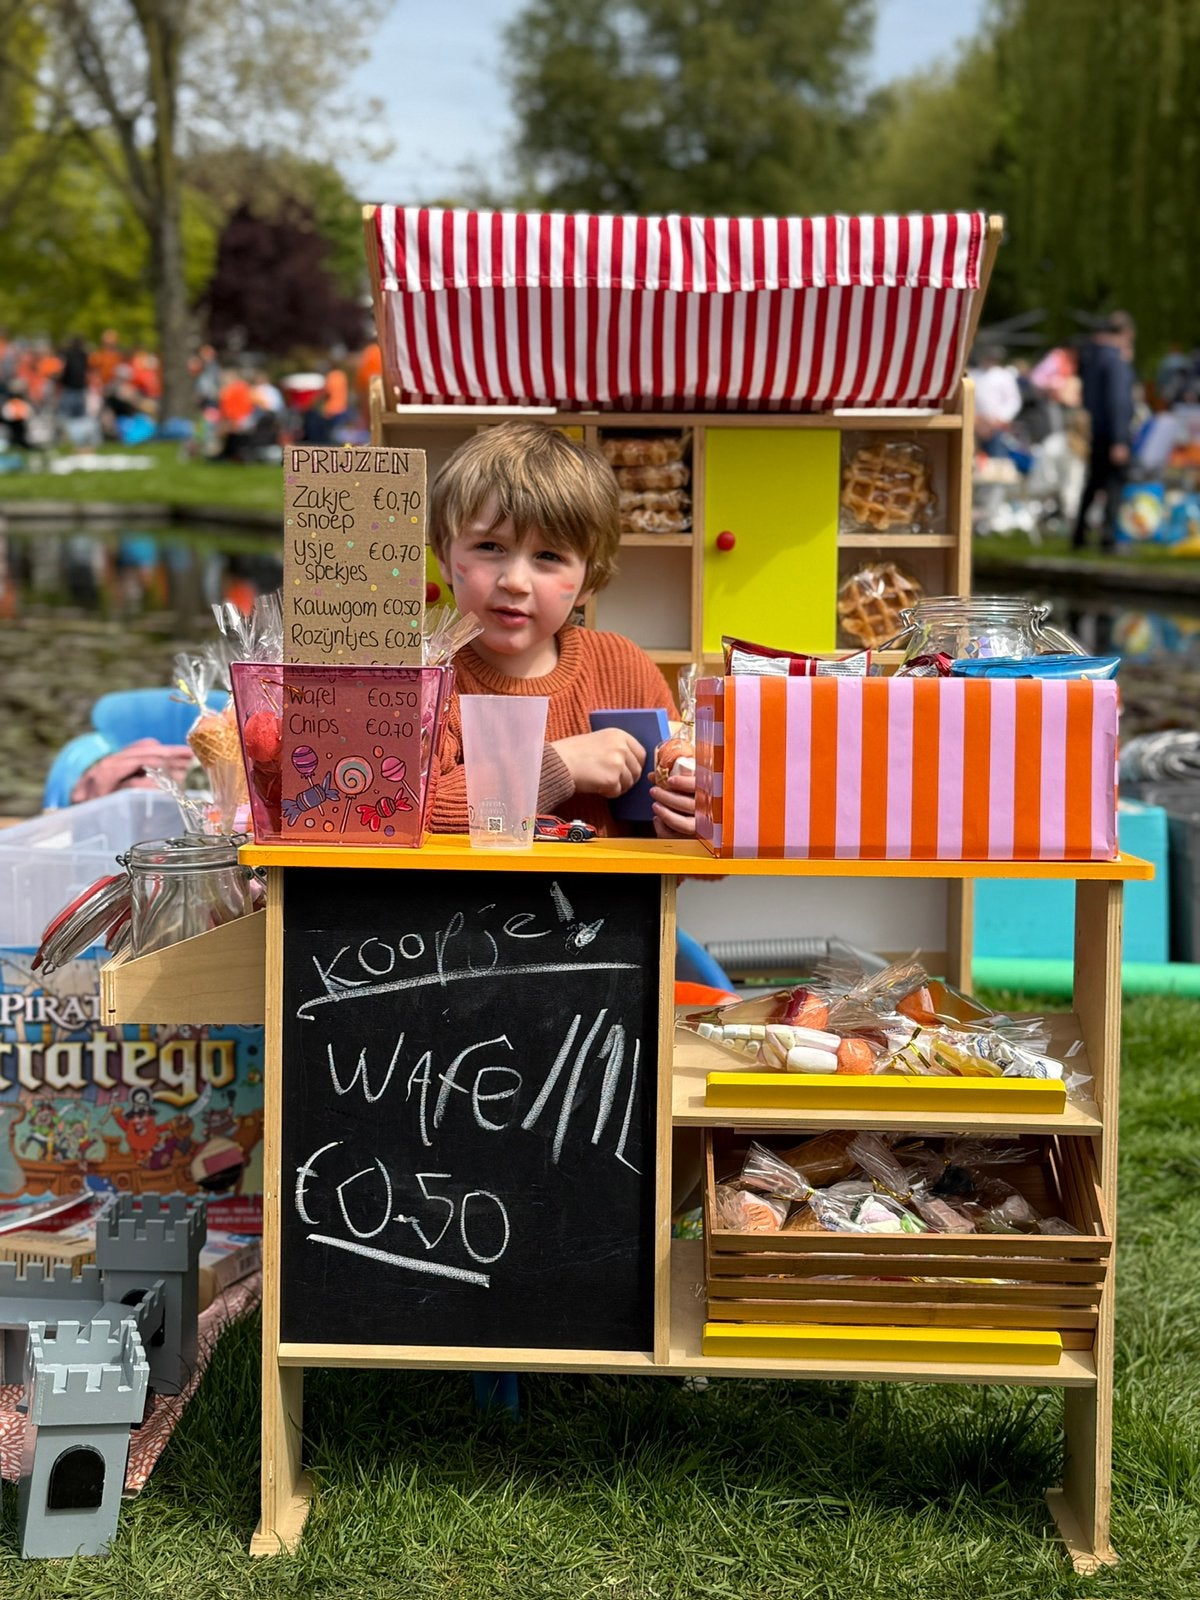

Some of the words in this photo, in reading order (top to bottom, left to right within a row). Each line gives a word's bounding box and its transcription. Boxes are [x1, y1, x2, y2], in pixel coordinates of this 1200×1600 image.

[292, 449, 411, 475] PRIJZEN
[292, 485, 355, 514] Zakje
[373, 486, 421, 515] €0.70
[296, 511, 355, 534] snoep
[369, 541, 421, 563] €0.70
[304, 562, 368, 585] spekjes
[293, 596, 378, 624] Kauwgom
[385, 628, 422, 649] €0.20
[289, 686, 336, 708] Wafel
[367, 687, 418, 708] €0.50
[289, 713, 340, 738] Chips
[366, 718, 414, 739] €0.70
[0, 993, 101, 1031] PIRAT
